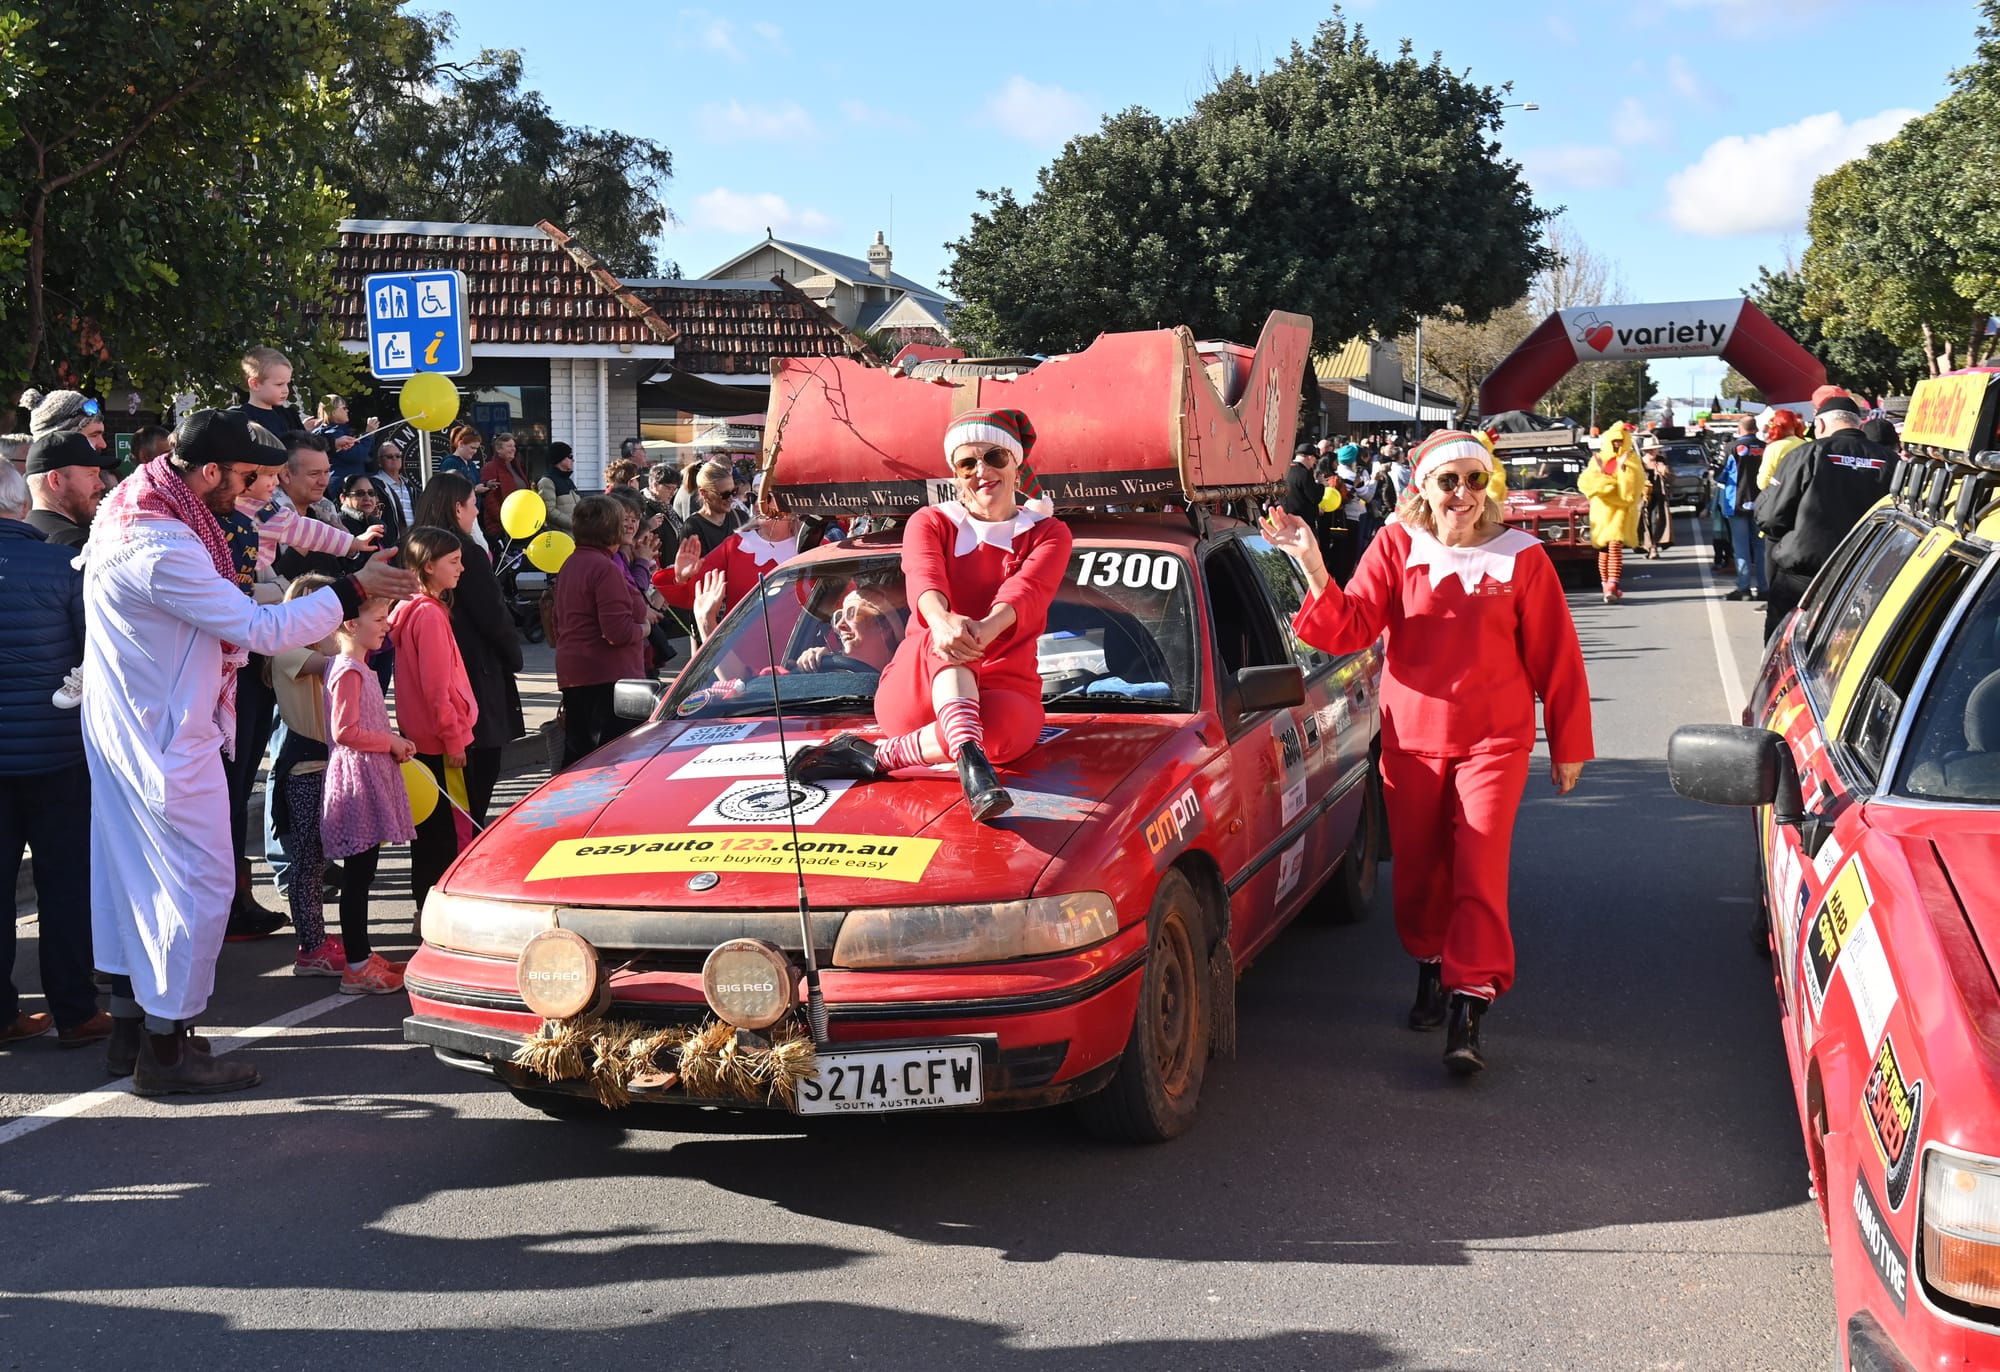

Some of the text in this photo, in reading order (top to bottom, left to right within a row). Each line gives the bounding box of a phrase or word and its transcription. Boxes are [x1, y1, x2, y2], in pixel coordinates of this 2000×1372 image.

[1617, 319, 1726, 347] variety
[1841, 455, 1872, 467] TOP GUN
[781, 489, 920, 507] Tim Adams Wines
[1062, 482, 1118, 499] Adams
[1120, 478, 1174, 495] Wines
[1076, 551, 1179, 591] 1300
[686, 730, 739, 742] STARS
[695, 724, 748, 735] SEVEN
[1145, 787, 1200, 855] ampm
[575, 838, 899, 857] easyauto123.com.au
[689, 853, 888, 871] car buying made easy
[1829, 889, 1848, 936] HARD
[1818, 912, 1839, 963] CORE
[528, 971, 580, 981] BIG RED
[716, 983, 774, 993] BIG RED
[835, 1096, 945, 1110] SOUTH AUSTRALIA
[1888, 1068, 1912, 1132] TREAD
[1872, 1079, 1904, 1162] SHED
[1853, 1178, 1881, 1256] KUMHO
[1880, 1232, 1906, 1302] TYRE
